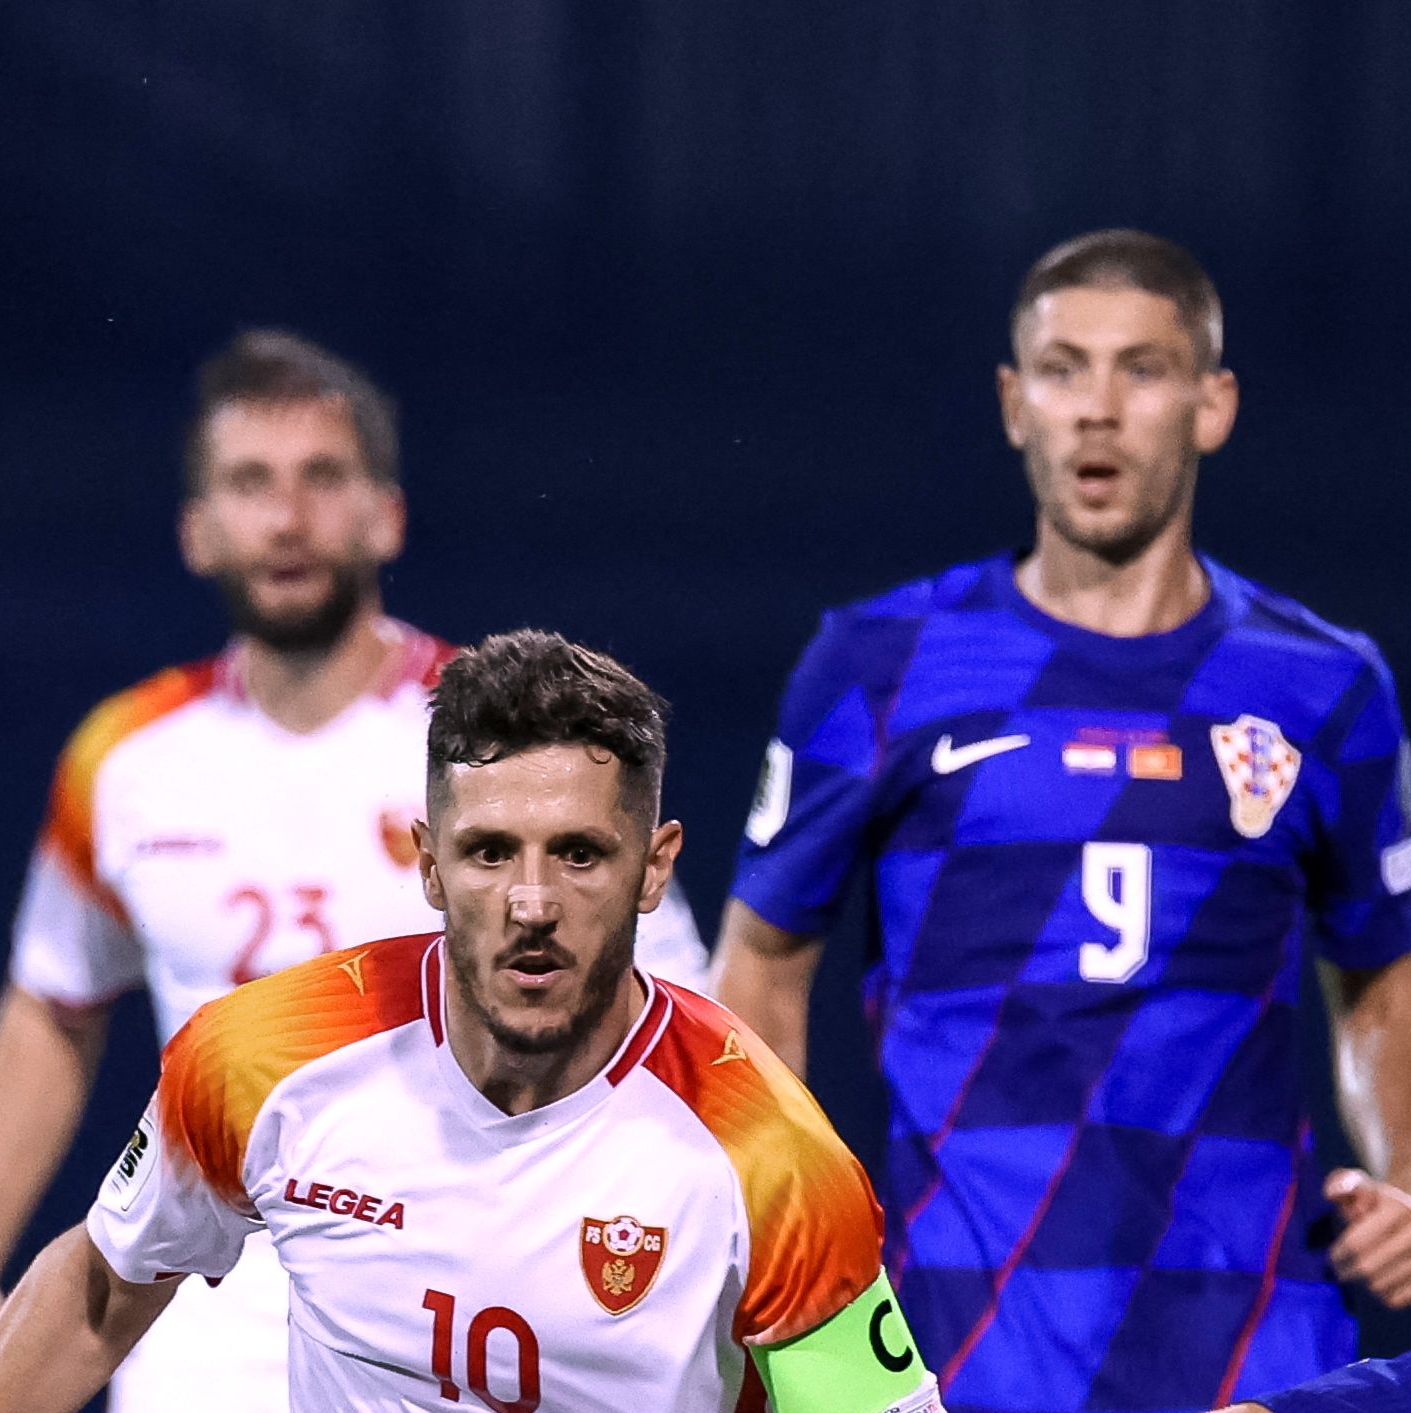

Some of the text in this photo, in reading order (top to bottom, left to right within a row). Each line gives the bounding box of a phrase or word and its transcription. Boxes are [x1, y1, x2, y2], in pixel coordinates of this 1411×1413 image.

[227, 884, 336, 984] 23
[1079, 841, 1153, 984] 9
[284, 1178, 405, 1230] LEGEA
[585, 1225, 661, 1252] FS CG
[868, 1299, 914, 1373] C
